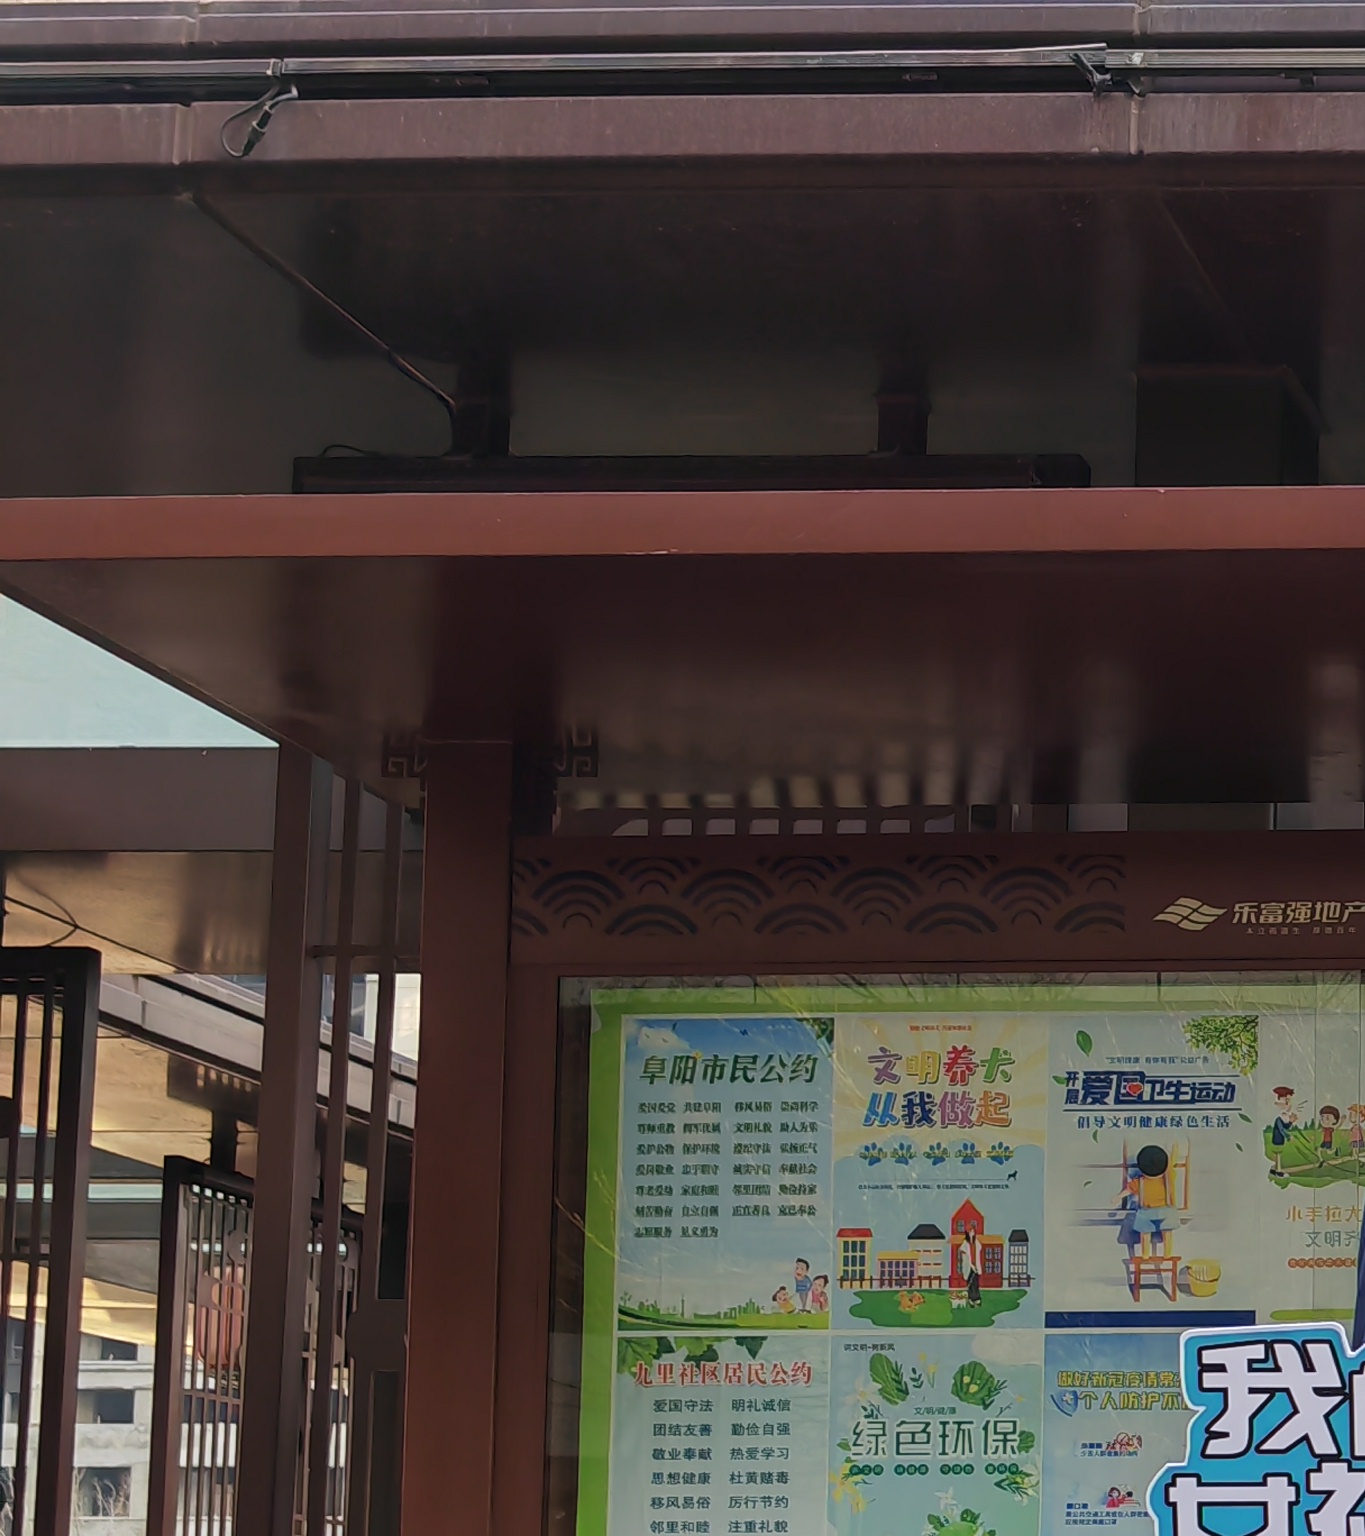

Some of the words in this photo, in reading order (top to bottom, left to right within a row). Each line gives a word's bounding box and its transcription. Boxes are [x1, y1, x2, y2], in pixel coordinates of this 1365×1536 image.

[639, 1053, 819, 1085] 阜阳市民公约
[867, 1045, 1015, 1086] 文明养犬
[1081, 1071, 1237, 1105] 爱国卫生运动
[862, 1090, 1012, 1128] 从我做起
[1078, 1116, 1229, 1129] 倡导文明健康绿色生活
[633, 1361, 812, 1387] 九里社区居民公约
[653, 1399, 714, 1413] 爱国守法
[731, 1399, 791, 1412] 明礼诚信
[653, 1423, 712, 1437] 团结友善
[731, 1422, 791, 1436] 勤俭自强
[851, 1419, 1020, 1457] 绿色环保
[652, 1447, 712, 1461] 敬业奉献
[730, 1447, 790, 1460] 热爱学习
[651, 1472, 711, 1486] 思想健康
[729, 1471, 790, 1485] 杜黄赌毒
[650, 1496, 711, 1510] 移风易俗
[728, 1496, 789, 1509] 厉行节约
[650, 1520, 710, 1534] 邻里和睦
[728, 1520, 789, 1534] 注重礼貌
